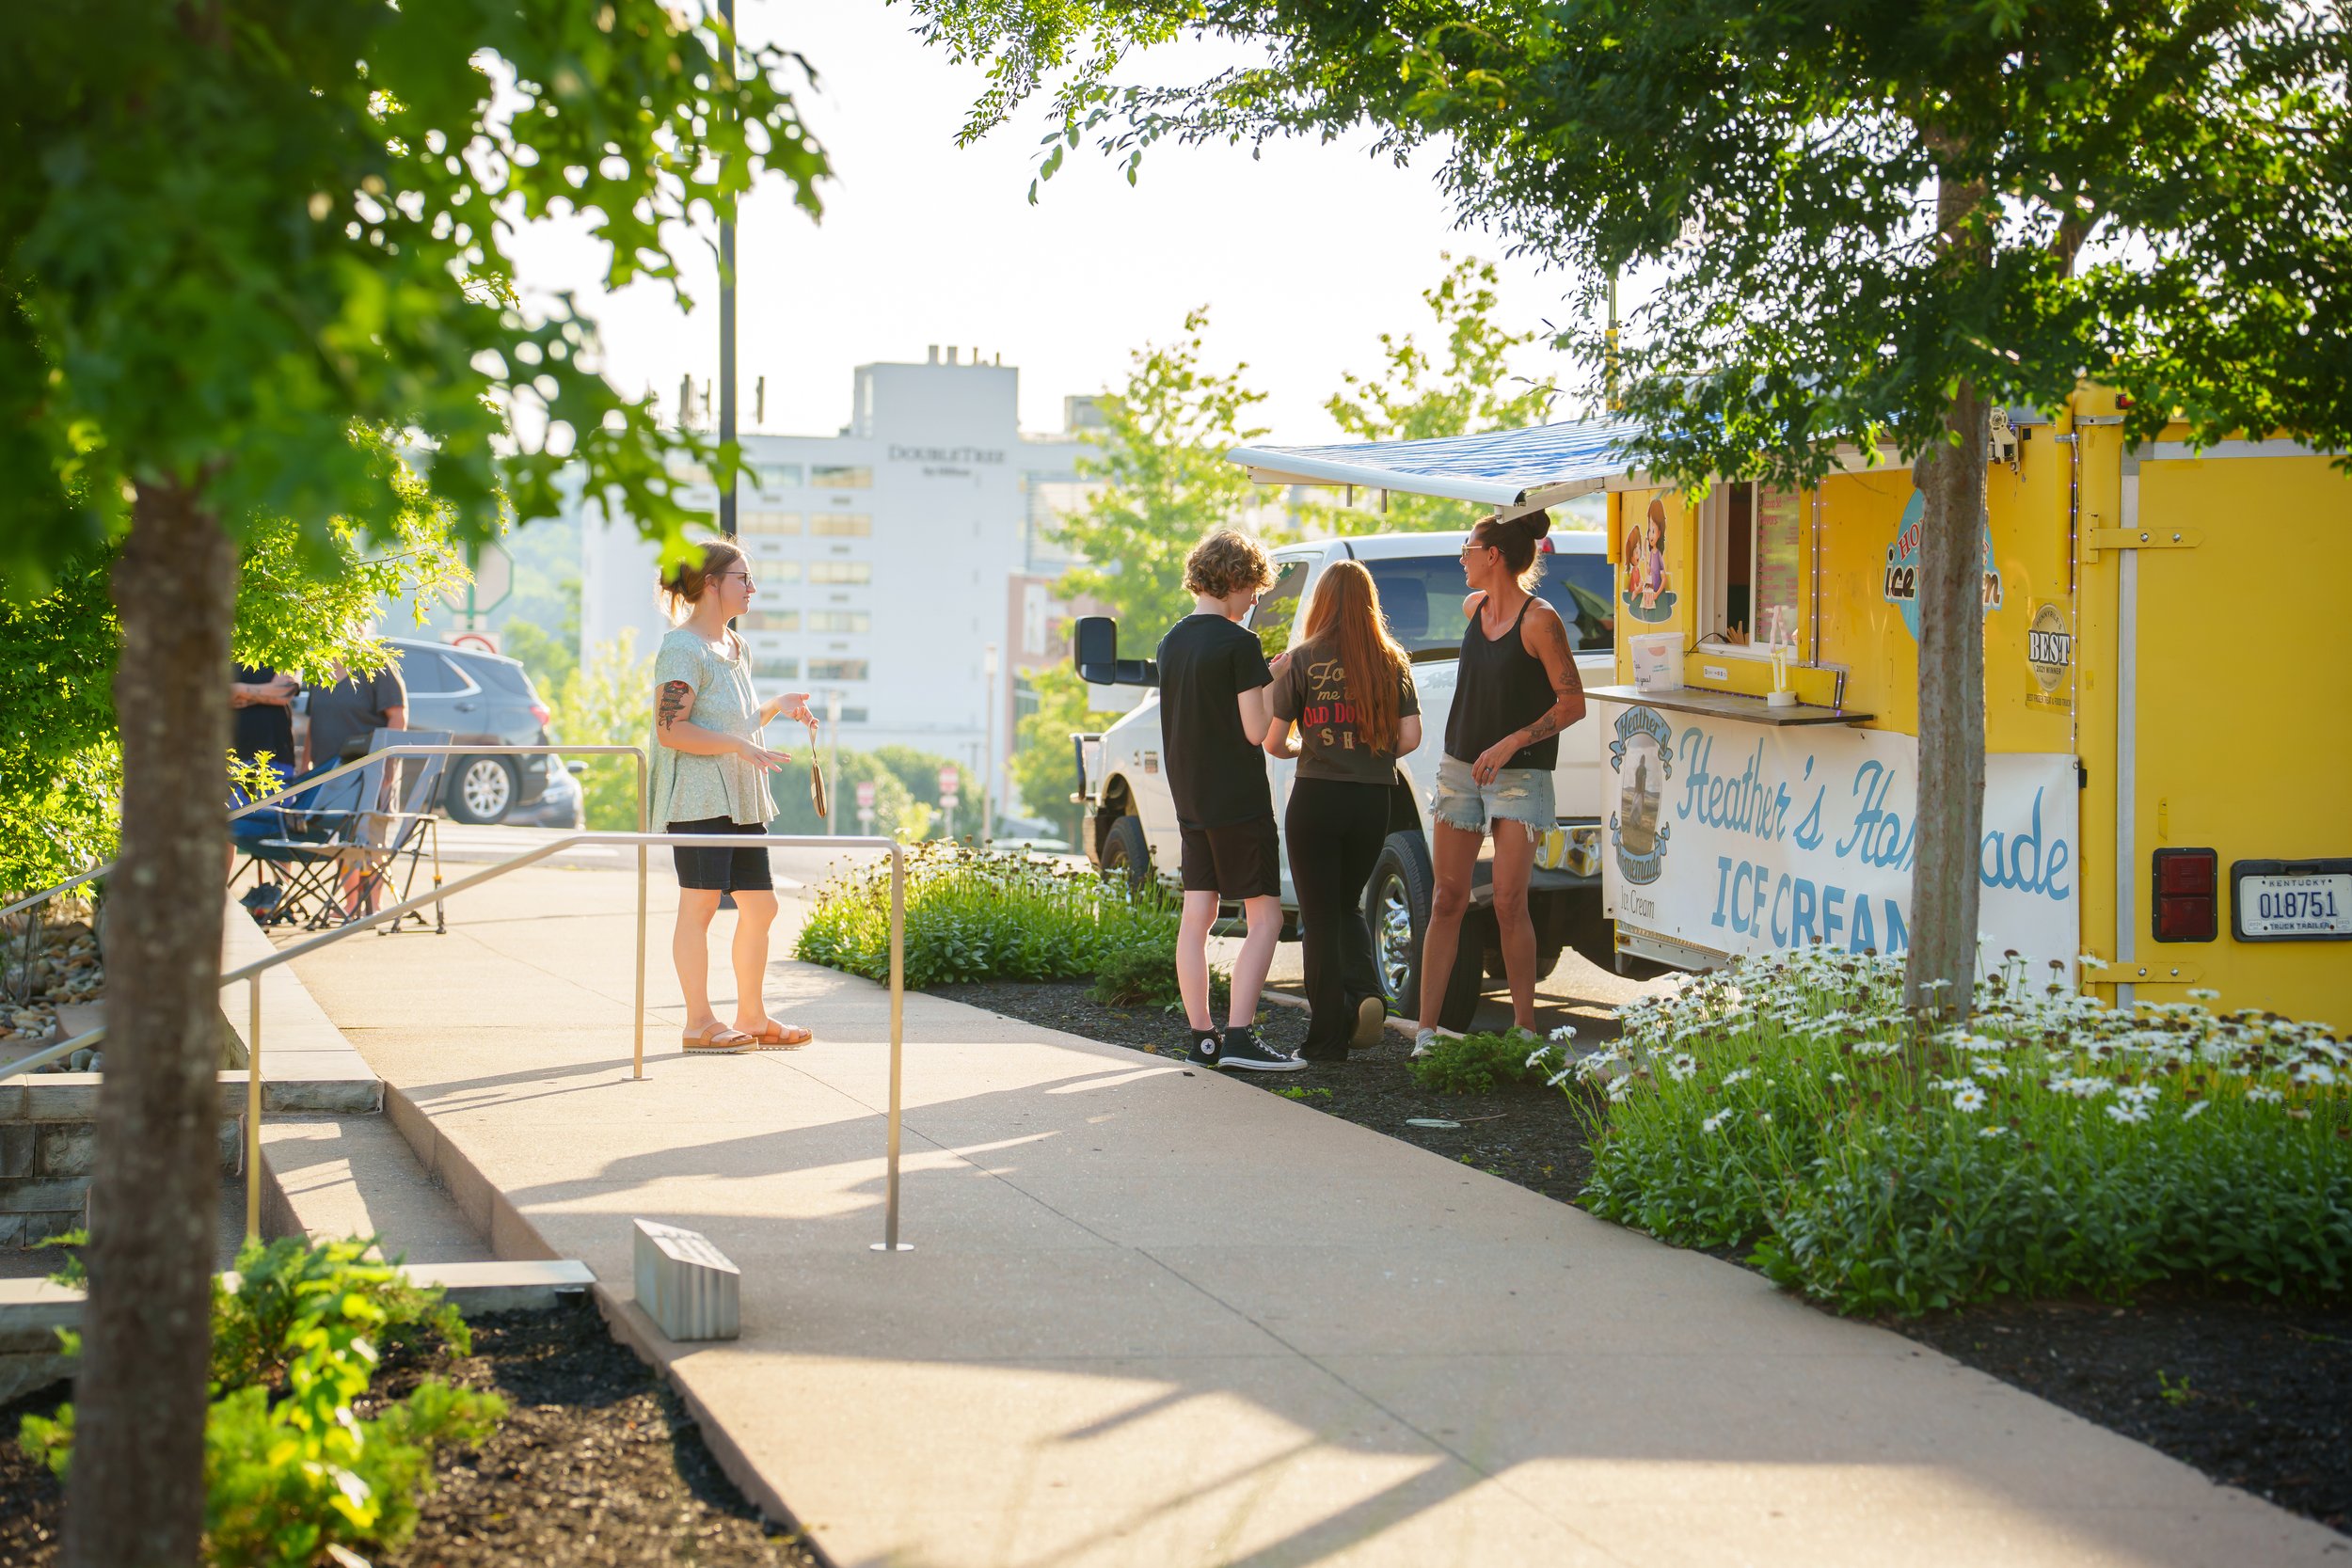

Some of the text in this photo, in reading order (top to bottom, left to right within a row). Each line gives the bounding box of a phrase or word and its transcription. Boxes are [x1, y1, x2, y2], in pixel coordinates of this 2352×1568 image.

[1885, 548, 1915, 598] ice
[2029, 630, 2070, 665] BEST
[2046, 666, 2061, 675] WINNER
[1317, 690, 1340, 701] me
[1303, 706, 1329, 728] OLD
[1677, 727, 2070, 901] Heather's Hoade
[2269, 879, 2327, 887] KENTUCKY
[1621, 885, 1655, 919] Ice Cream
[1710, 856, 1769, 939] ICE
[2260, 891, 2337, 918] 018751
[2296, 922, 2329, 930] TRAILER
